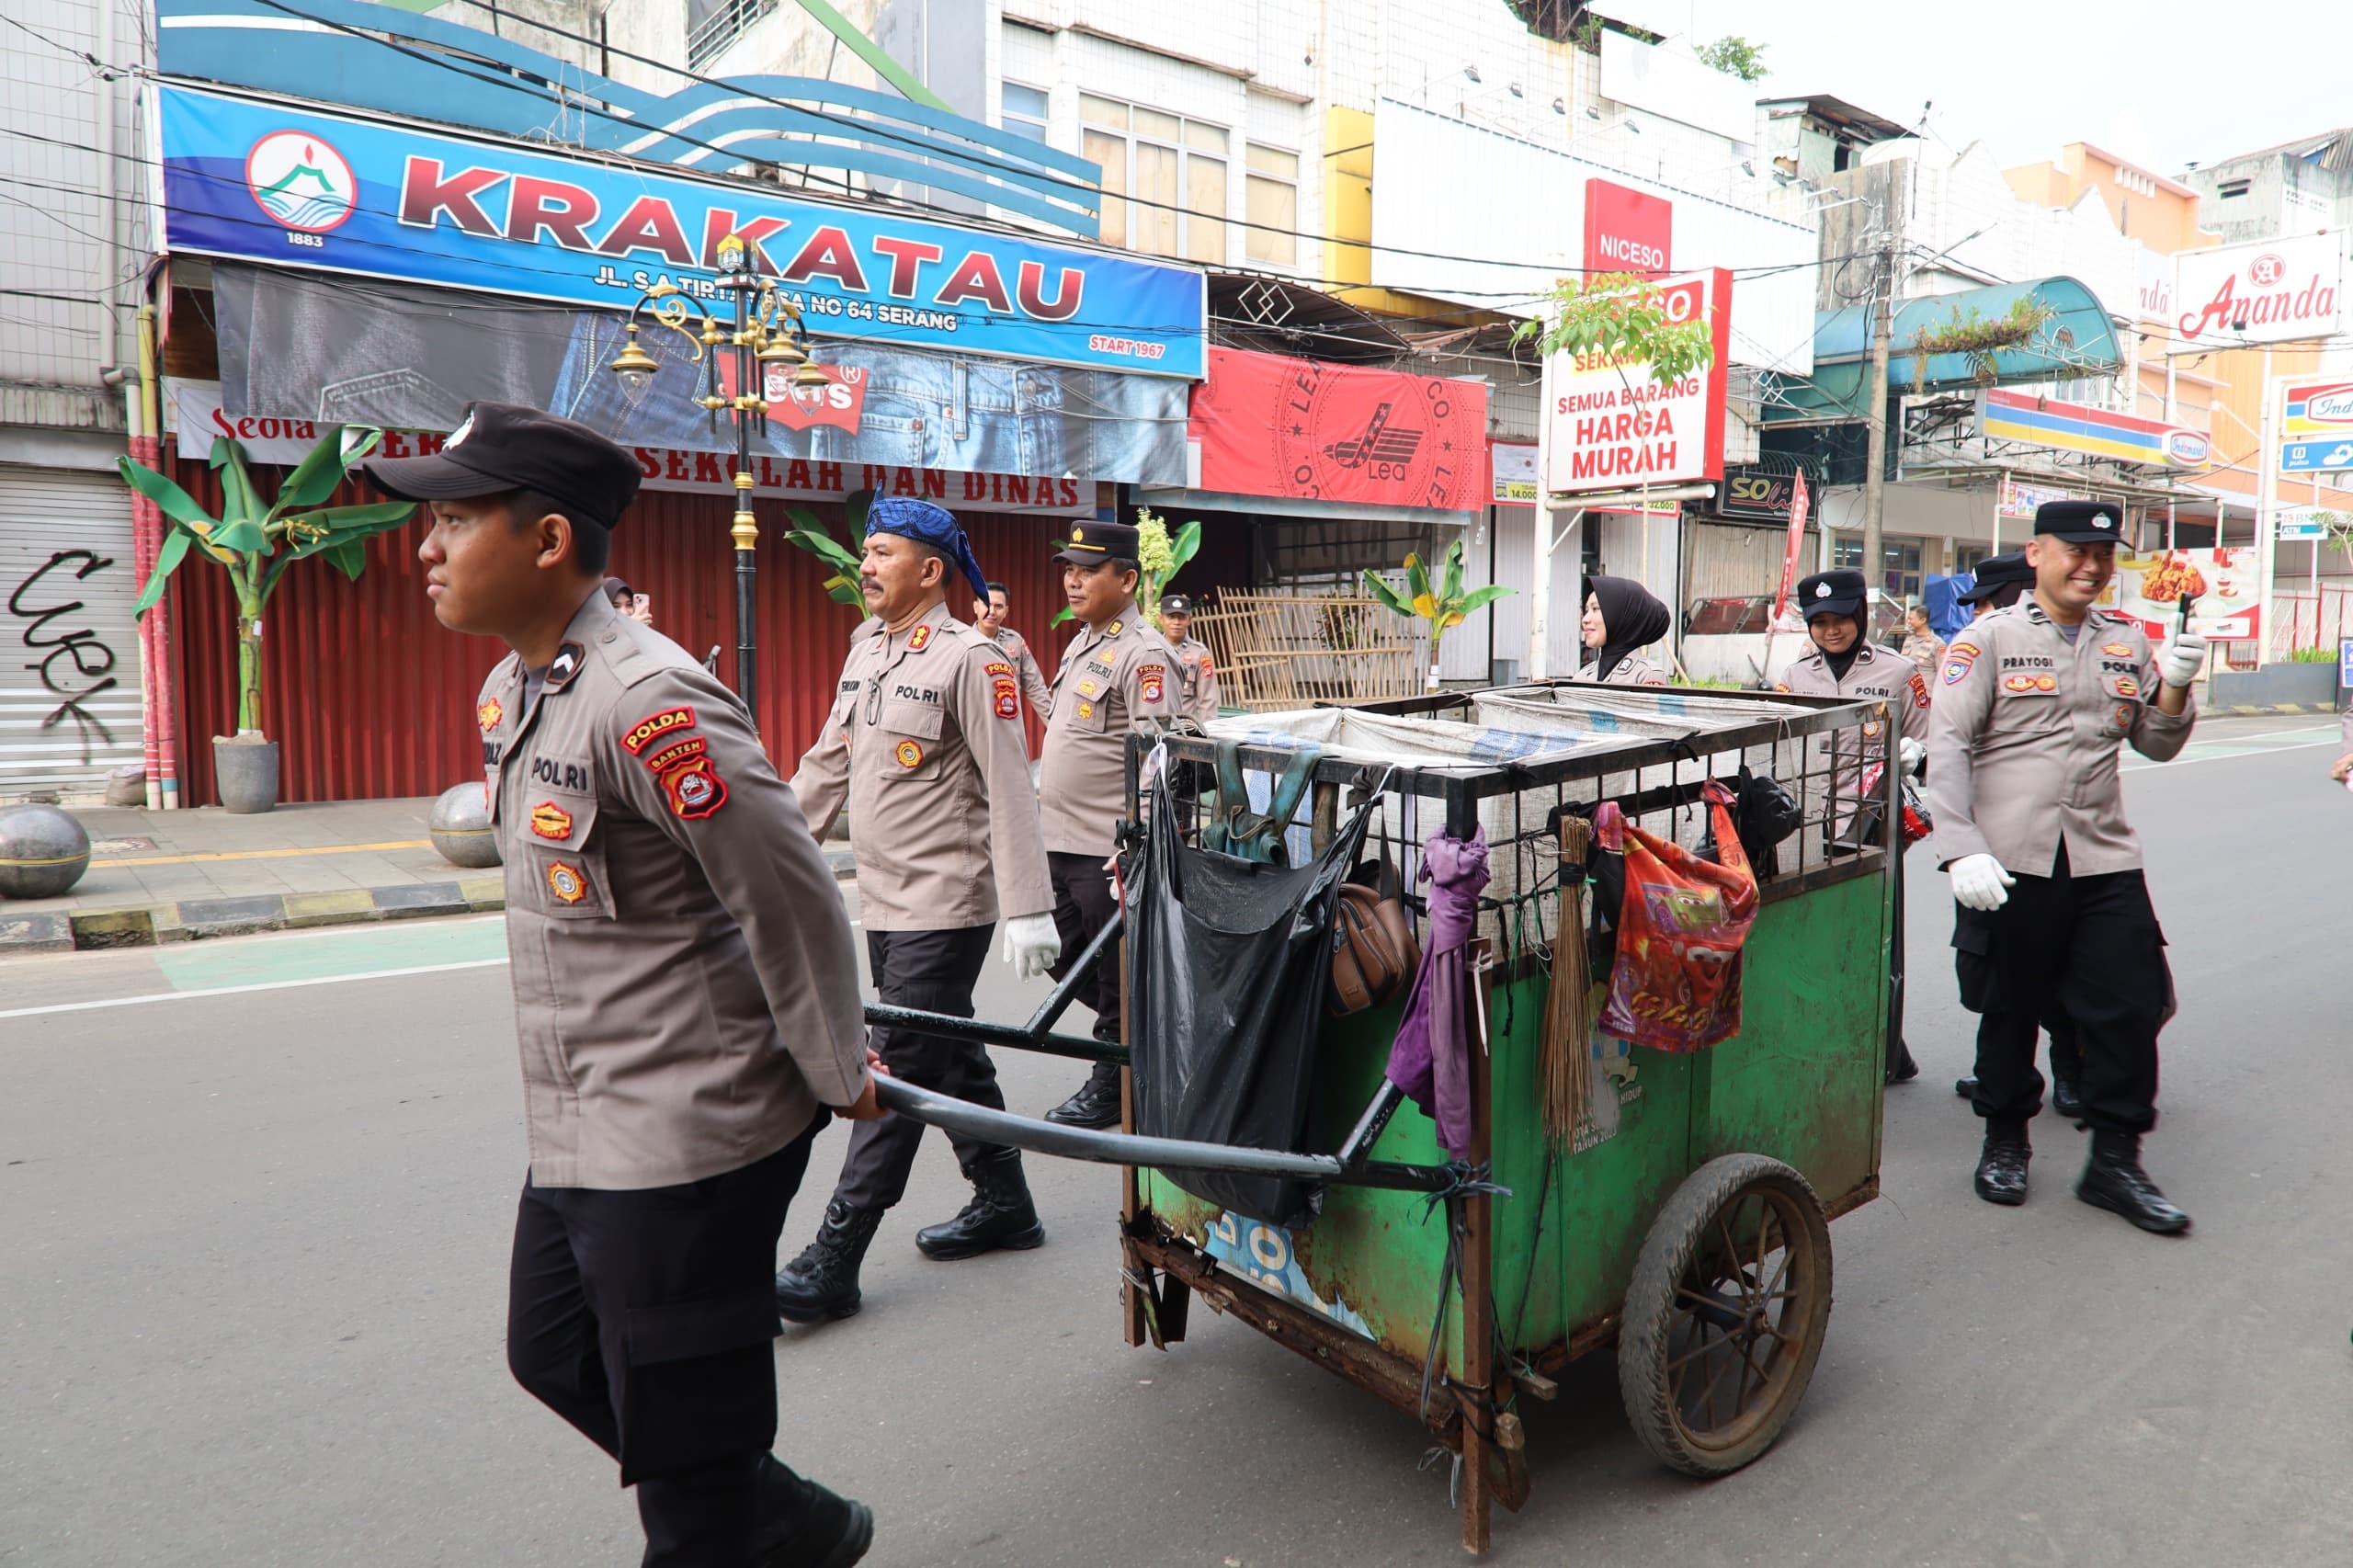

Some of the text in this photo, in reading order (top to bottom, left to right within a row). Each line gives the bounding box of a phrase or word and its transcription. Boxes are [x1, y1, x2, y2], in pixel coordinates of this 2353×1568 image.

[287, 232, 324, 248] 1883
[398, 154, 1086, 322] KRAKATAU
[1600, 233, 1664, 269] NICESO
[595, 266, 628, 288] JL.
[811, 296, 842, 315] NO
[847, 301, 873, 320] 64
[877, 305, 957, 332] SERANG
[2178, 274, 2335, 339] Ananda
[1089, 335, 1165, 359] START 1967
[1559, 378, 1699, 415] SEMUA BARANG
[1576, 408, 1674, 446] HARGA
[1368, 462, 1406, 482] Lea
[1572, 441, 1677, 480] MURAH
[962, 473, 1079, 508] DINAS
[1086, 662, 1113, 679] POLRI
[2003, 657, 2054, 668] PRAYOGI
[895, 685, 938, 703] POLRI
[1855, 686, 1889, 698] POLRI
[627, 711, 688, 749] POLDA
[651, 742, 700, 768] BANTEN
[531, 756, 587, 790] POLRI
